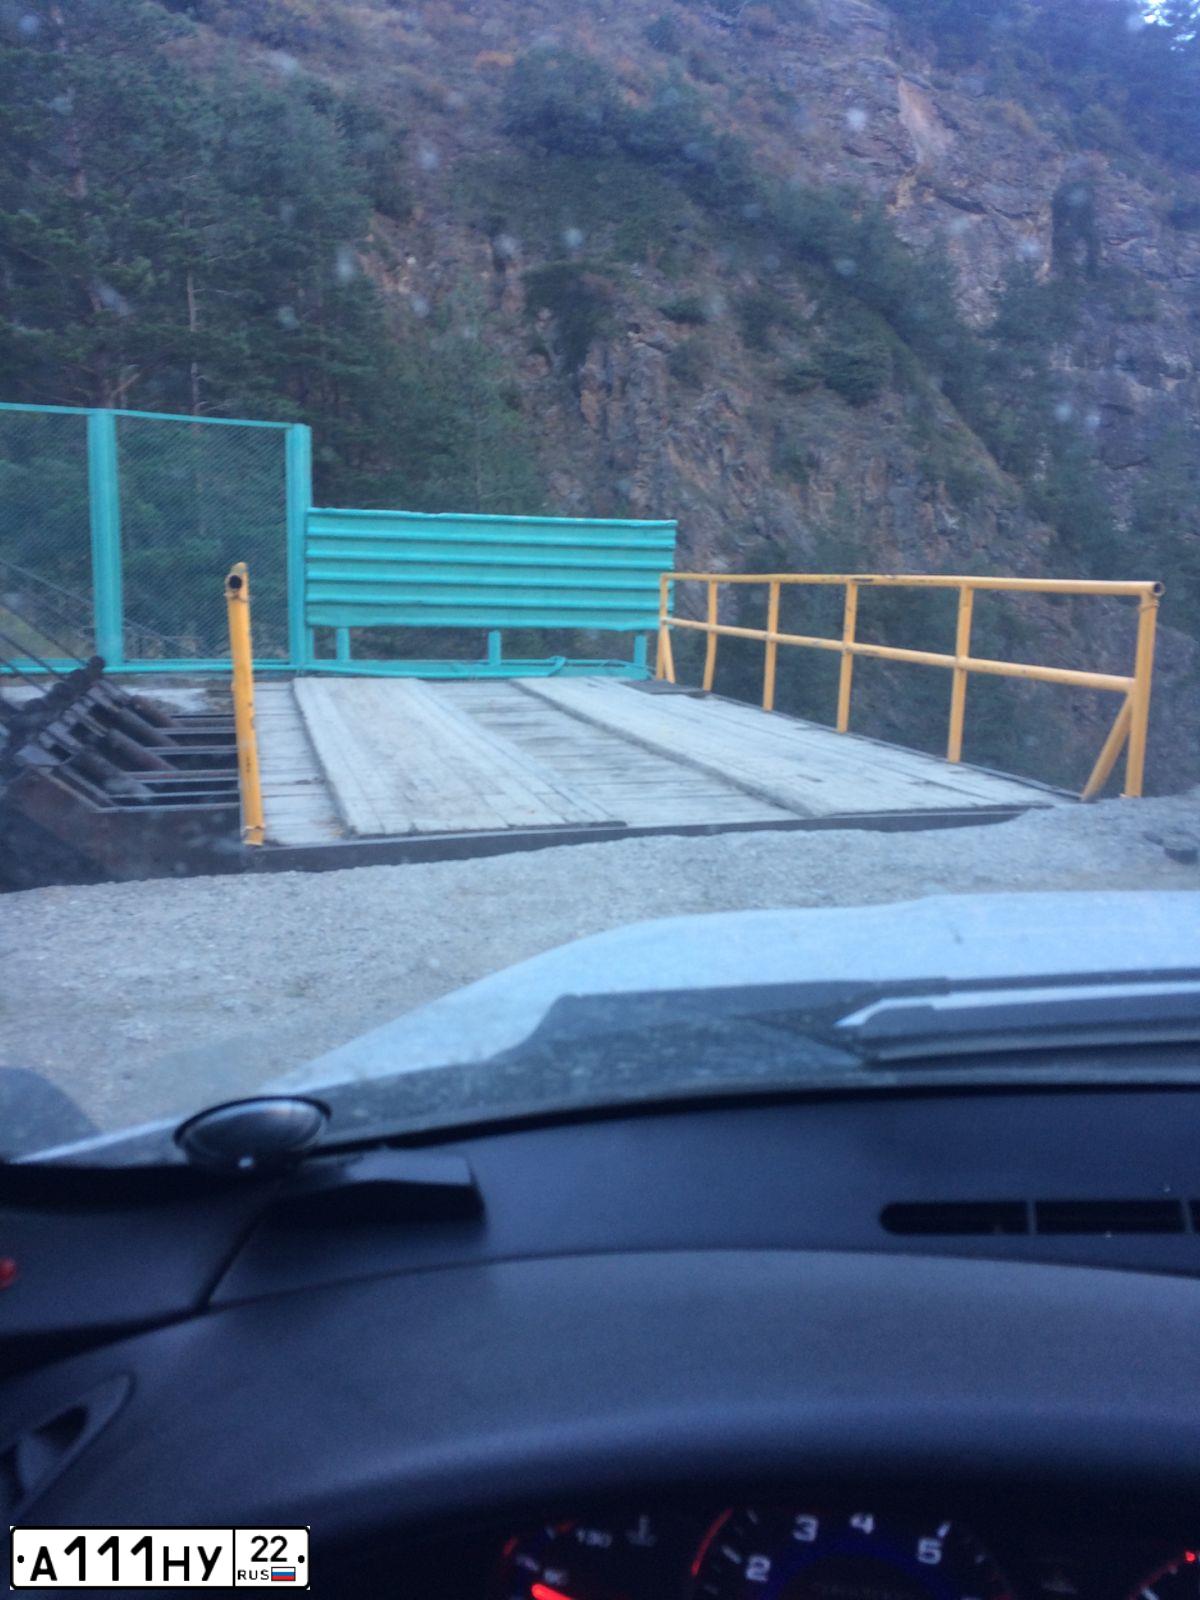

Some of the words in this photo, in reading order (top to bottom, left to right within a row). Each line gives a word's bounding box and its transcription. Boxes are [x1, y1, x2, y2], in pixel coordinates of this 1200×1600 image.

[793, 1513, 819, 1542] 3
[849, 1512, 875, 1535] 4
[917, 1537, 942, 1565] 5
[745, 1554, 771, 1582] 2
